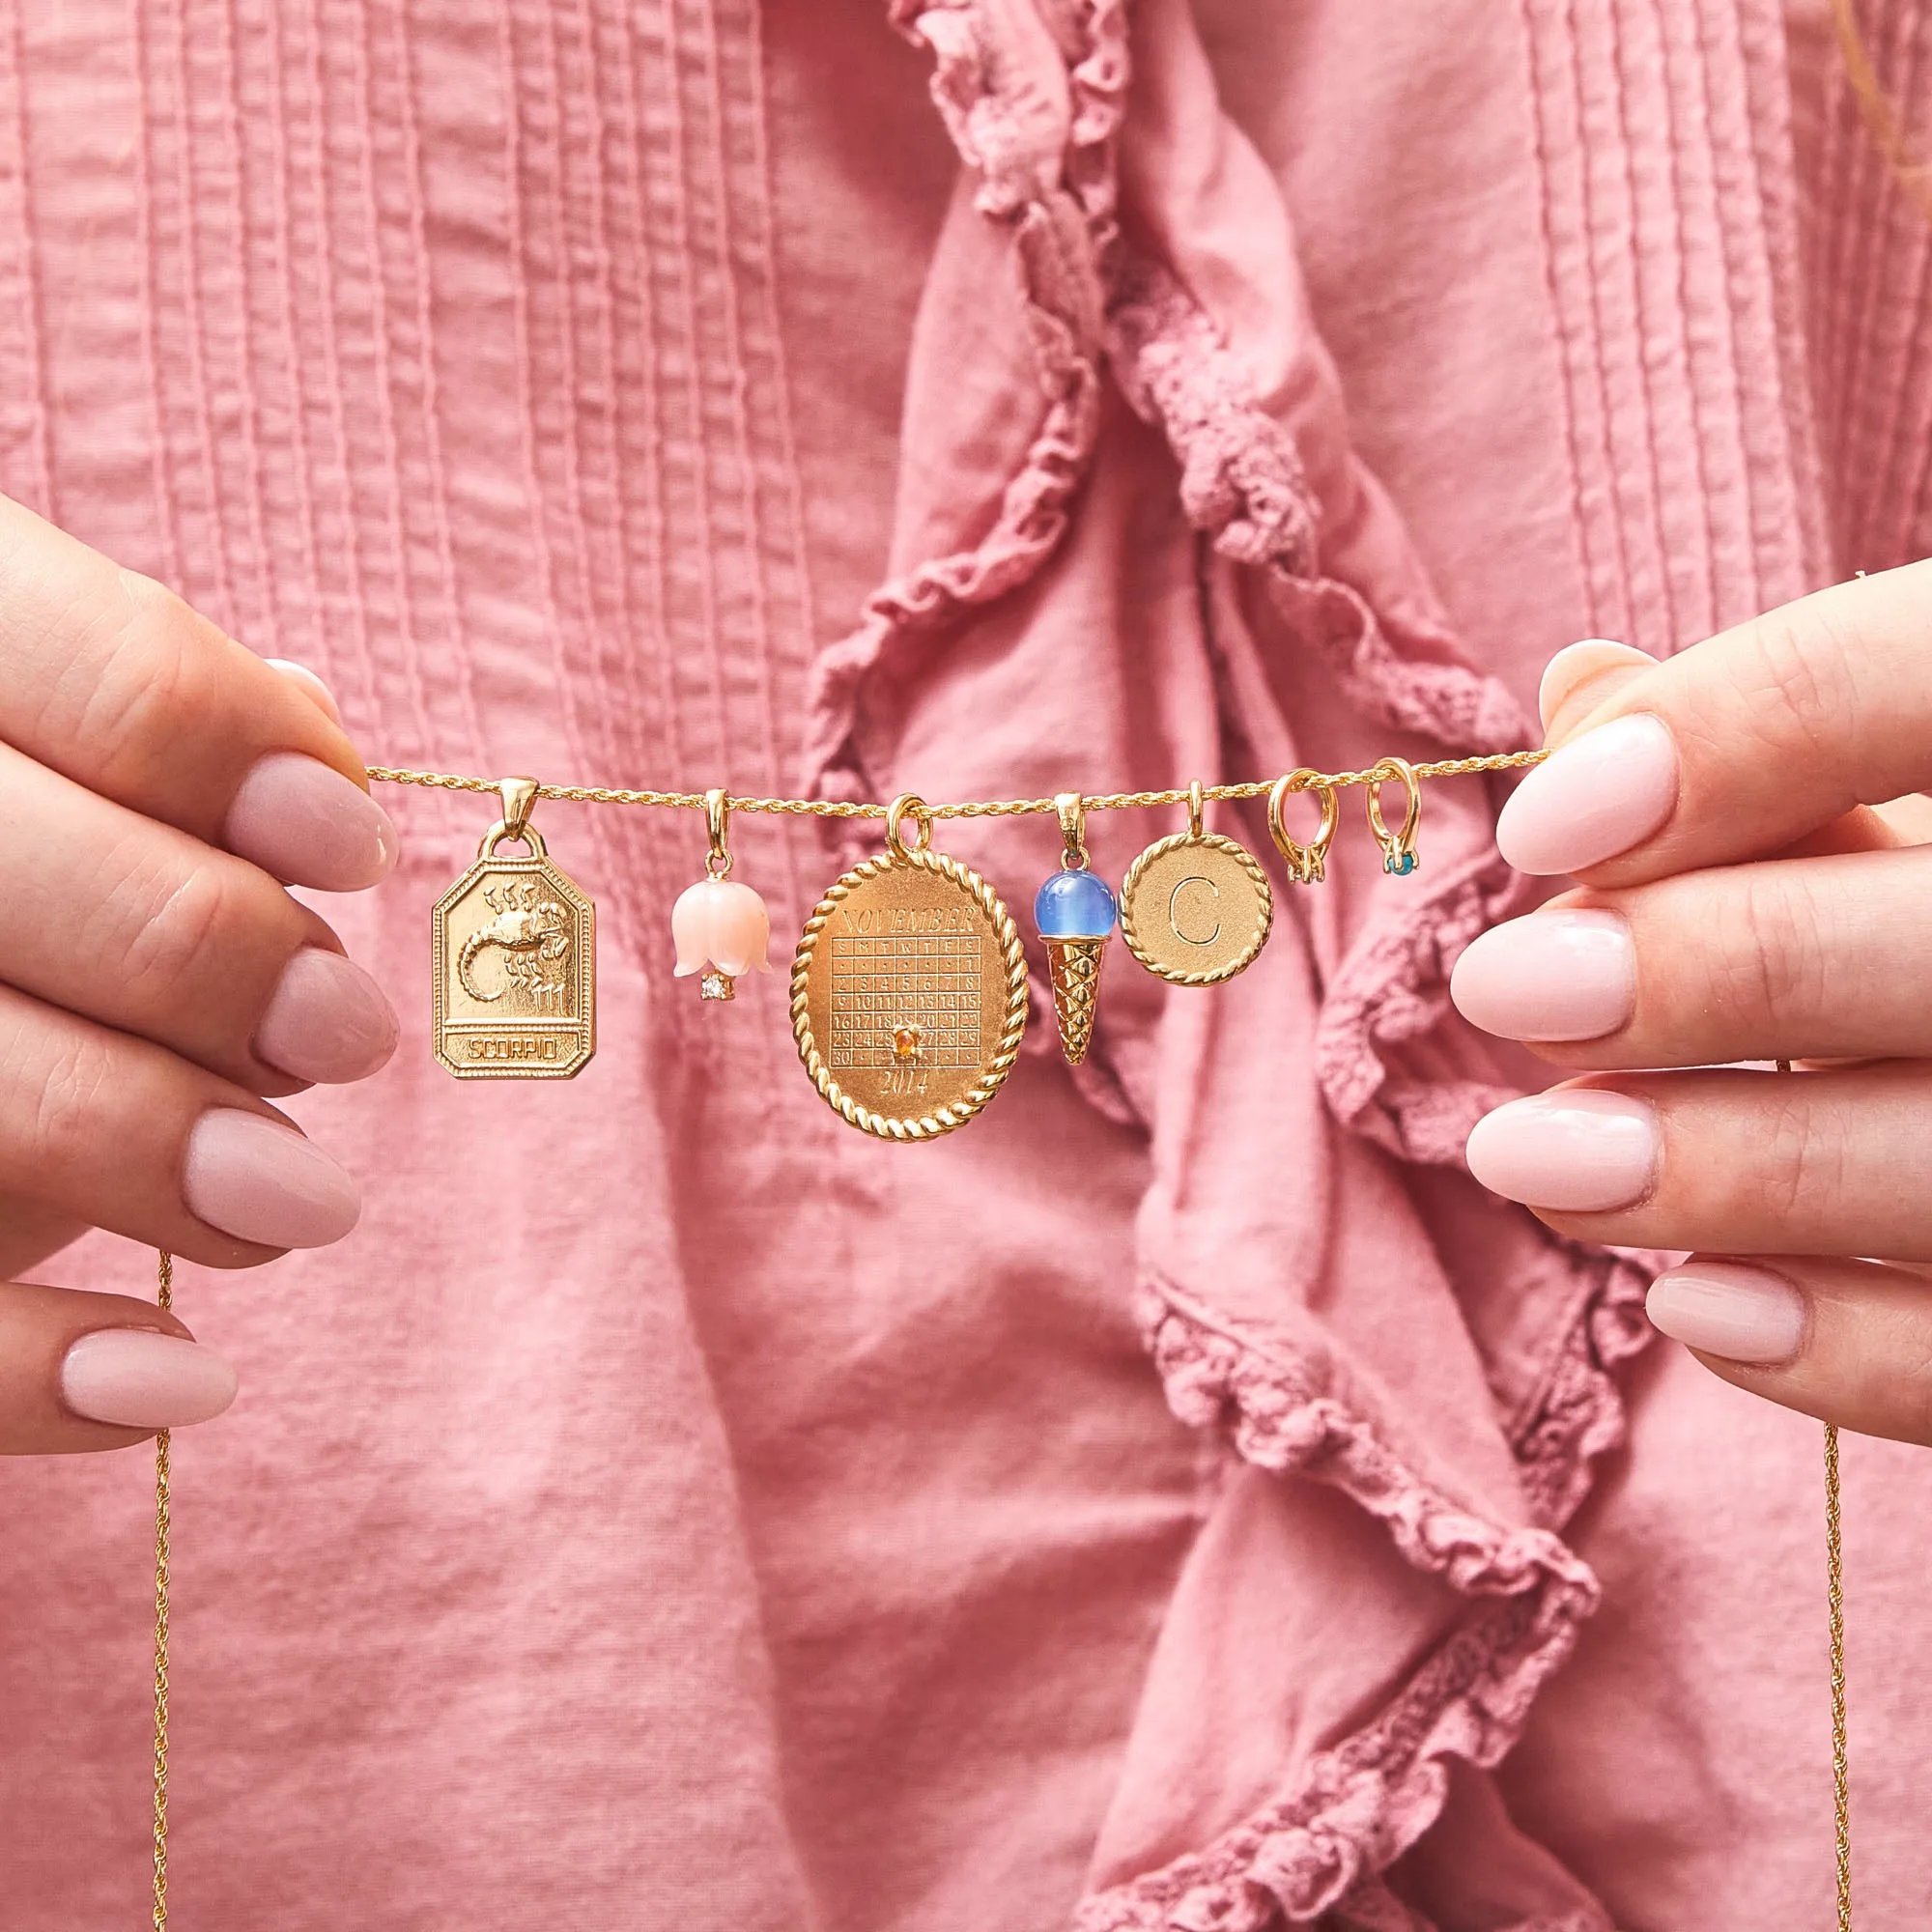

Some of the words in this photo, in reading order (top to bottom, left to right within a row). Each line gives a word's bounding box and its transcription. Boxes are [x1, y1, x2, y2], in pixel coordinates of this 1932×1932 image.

[1170, 876, 1221, 946] C
[837, 907, 976, 934] NOVEMBER
[838, 943, 846, 952] S
[859, 942, 868, 952] M
[881, 943, 889, 952] T
[901, 943, 912, 952] W
[923, 943, 931, 952] T
[945, 942, 952, 952] F
[966, 941, 973, 951] S
[967, 957, 972, 972] 1
[838, 979, 846, 991] 2
[861, 977, 867, 991] 3
[881, 977, 889, 991] 4
[902, 977, 910, 990] 5
[923, 978, 930, 991] 6
[945, 977, 952, 990] 7
[966, 976, 974, 990] 8
[838, 997, 846, 1010] 9
[856, 996, 870, 1009] 10
[878, 996, 892, 1009] 11
[899, 995, 913, 1009] 12
[921, 995, 934, 1009] 13
[942, 995, 954, 1009] 14
[962, 995, 977, 1009] 15
[835, 1015, 850, 1029] 16
[856, 1015, 869, 1029] 17
[877, 1015, 892, 1029] 18
[920, 1014, 935, 1028] 20
[941, 1014, 955, 1028] 21
[961, 1013, 977, 1028] 22
[834, 1033, 850, 1046] 23
[855, 1033, 870, 1046] 24
[876, 1033, 892, 1046] 25
[920, 1032, 933, 1046] 27
[940, 1032, 955, 1046] 28
[961, 1032, 976, 1046] 29
[469, 1037, 557, 1059] SCORPIO
[834, 1051, 850, 1065] 30
[881, 1070, 929, 1094] 2014
